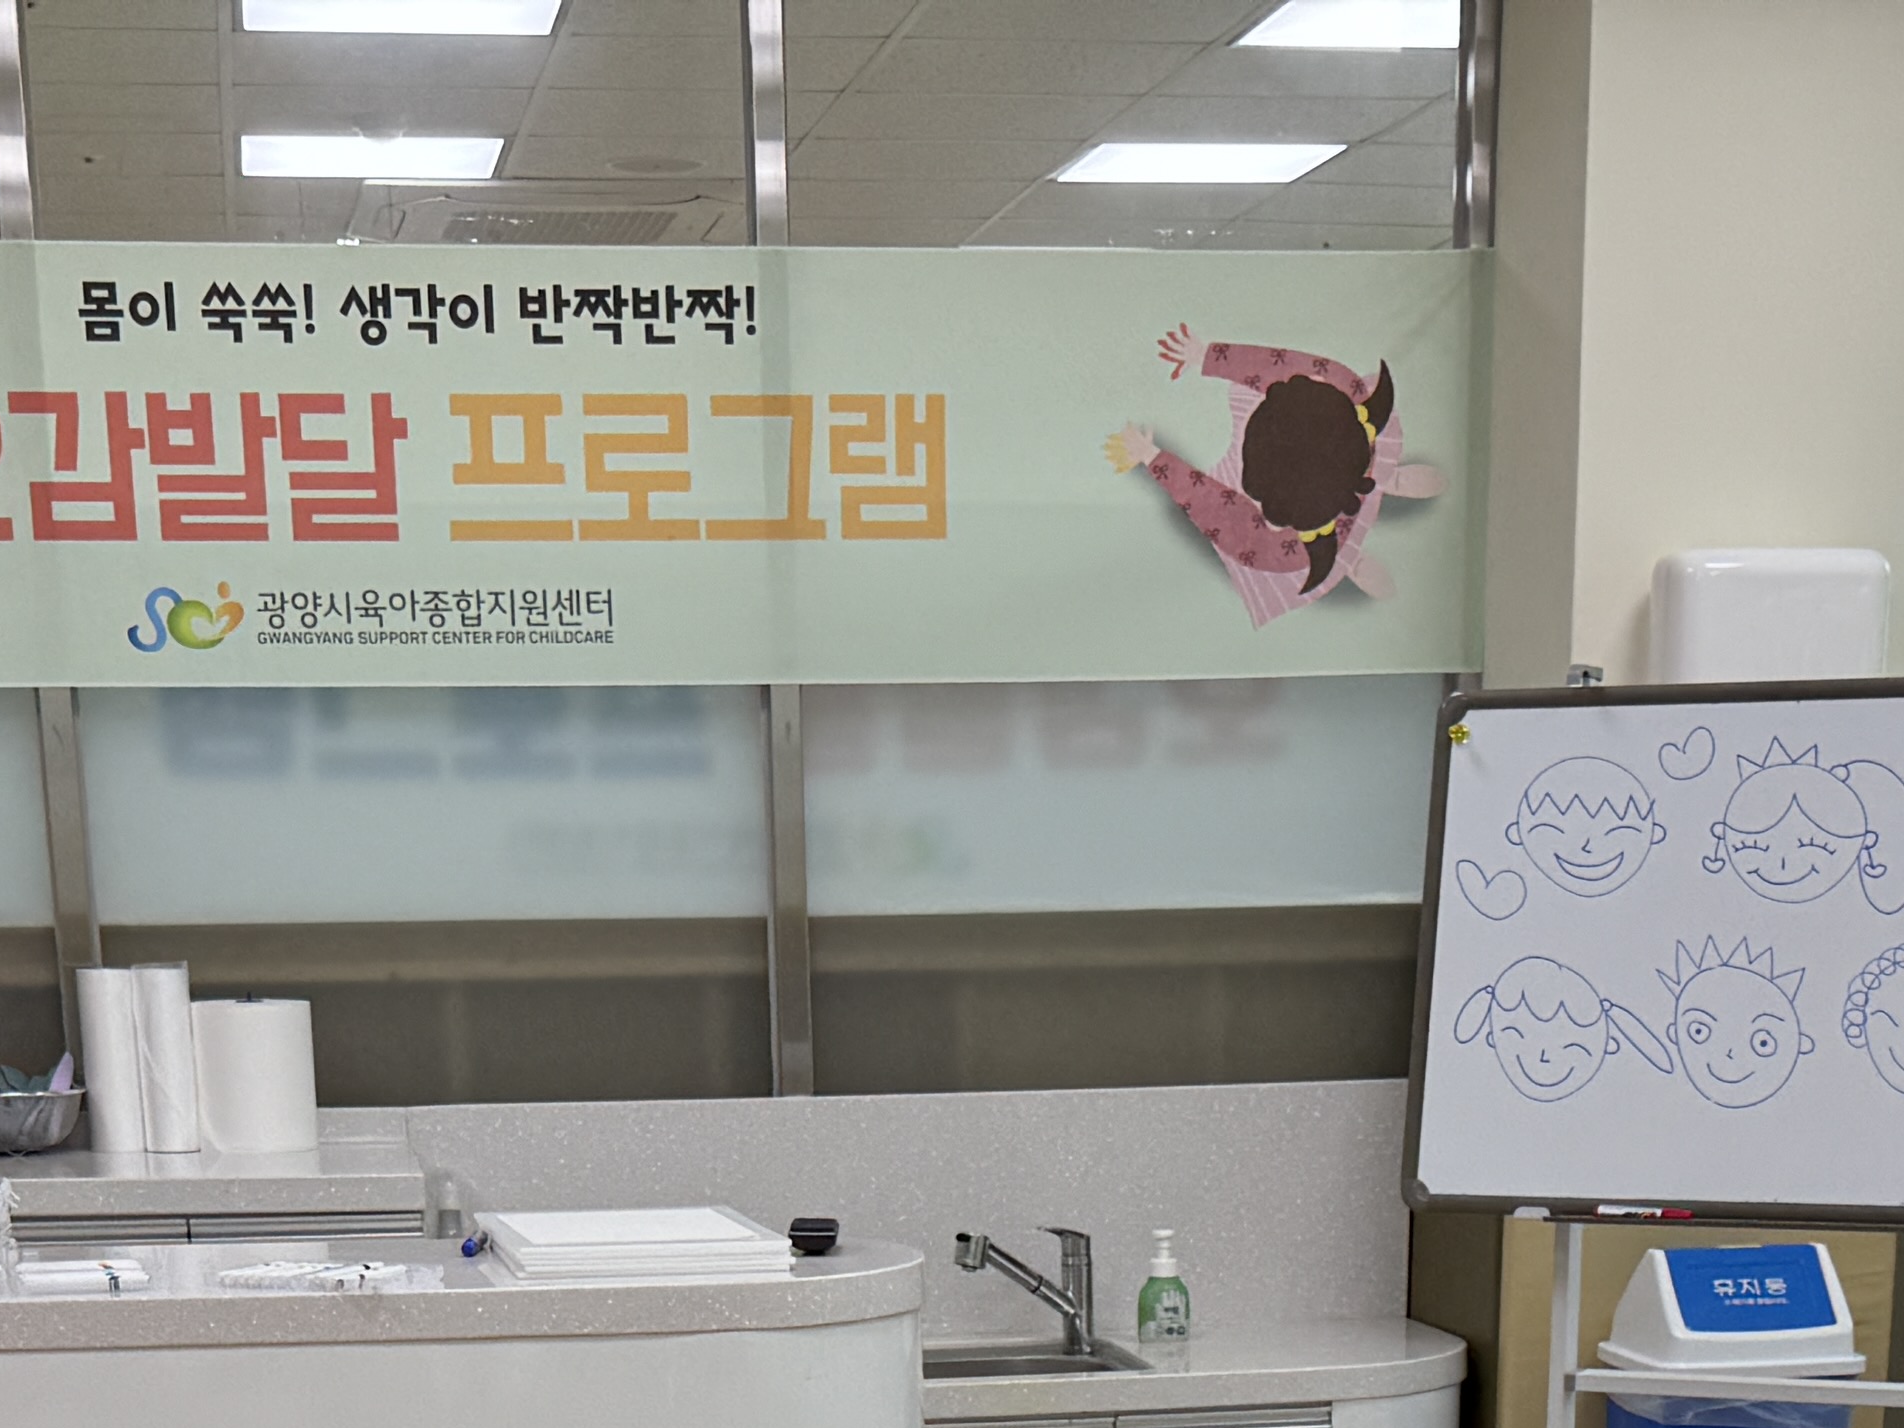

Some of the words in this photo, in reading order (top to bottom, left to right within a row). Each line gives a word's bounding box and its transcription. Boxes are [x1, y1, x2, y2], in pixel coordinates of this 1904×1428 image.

[78, 281, 177, 342] 몸이
[200, 281, 316, 344] 쑥쑥!
[339, 283, 495, 346] 생각이
[518, 284, 757, 345] 반짝반짝!
[449, 392, 949, 542] 프로그램
[257, 588, 613, 629] 광양시육아종합지원센터
[257, 630, 354, 645] GWANGYANG
[357, 630, 428, 645] SUPPORT
[431, 630, 493, 645] CENTER
[495, 630, 526, 645] FOR
[528, 629, 614, 645] CHILDCARE
